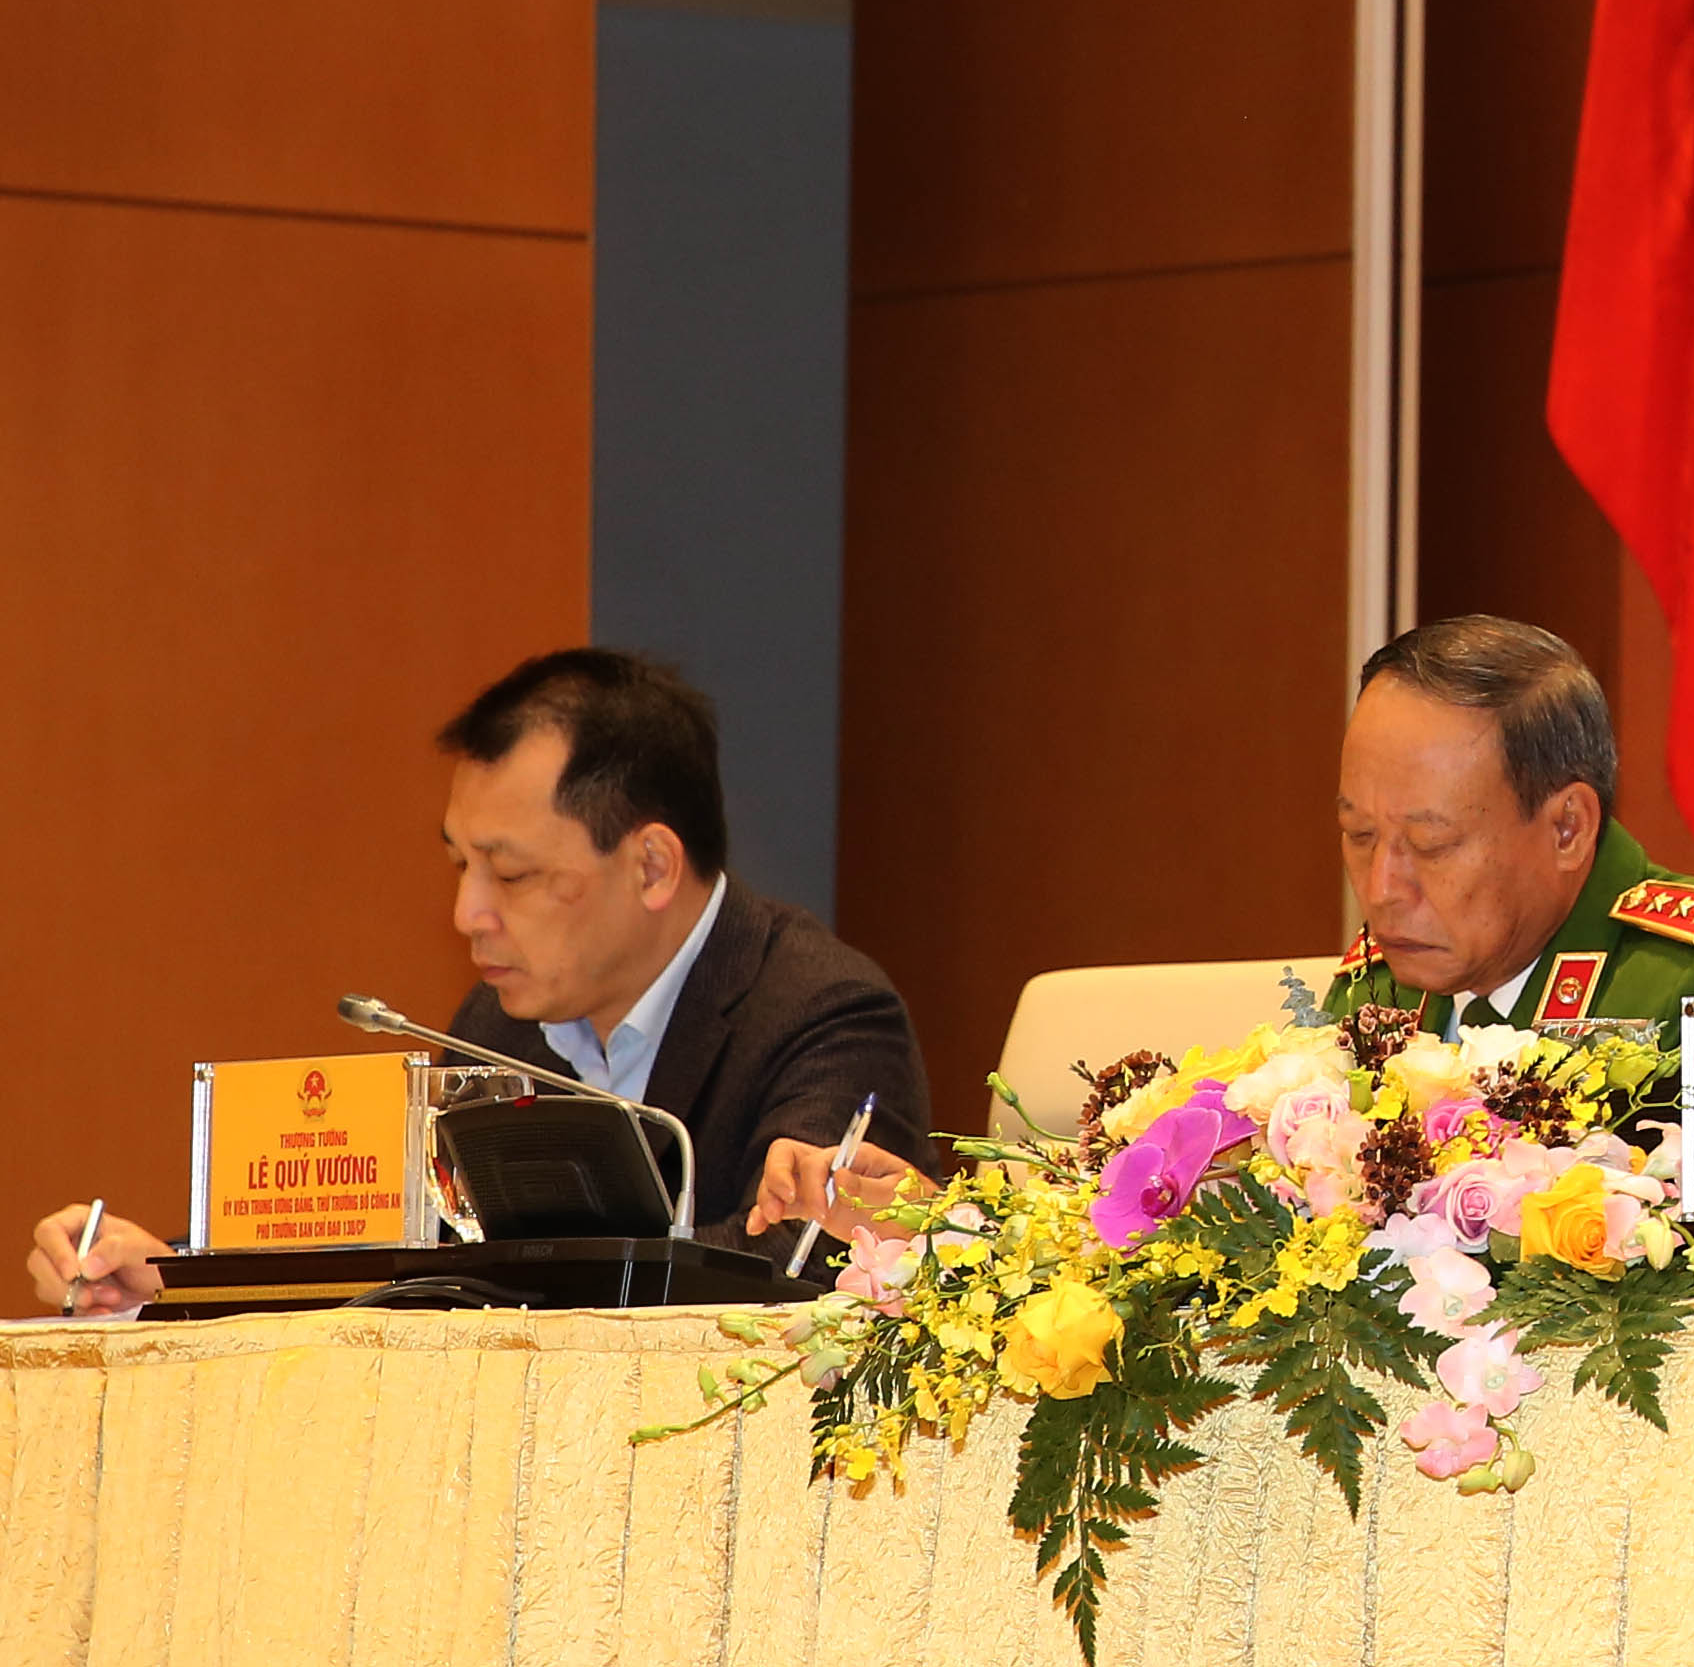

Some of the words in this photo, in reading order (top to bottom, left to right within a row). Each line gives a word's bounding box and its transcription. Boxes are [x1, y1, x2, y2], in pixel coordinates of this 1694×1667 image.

[248, 1155, 269, 1189] LÊ
[275, 1153, 310, 1191] QUÝ
[316, 1154, 377, 1186] VƯƠNG
